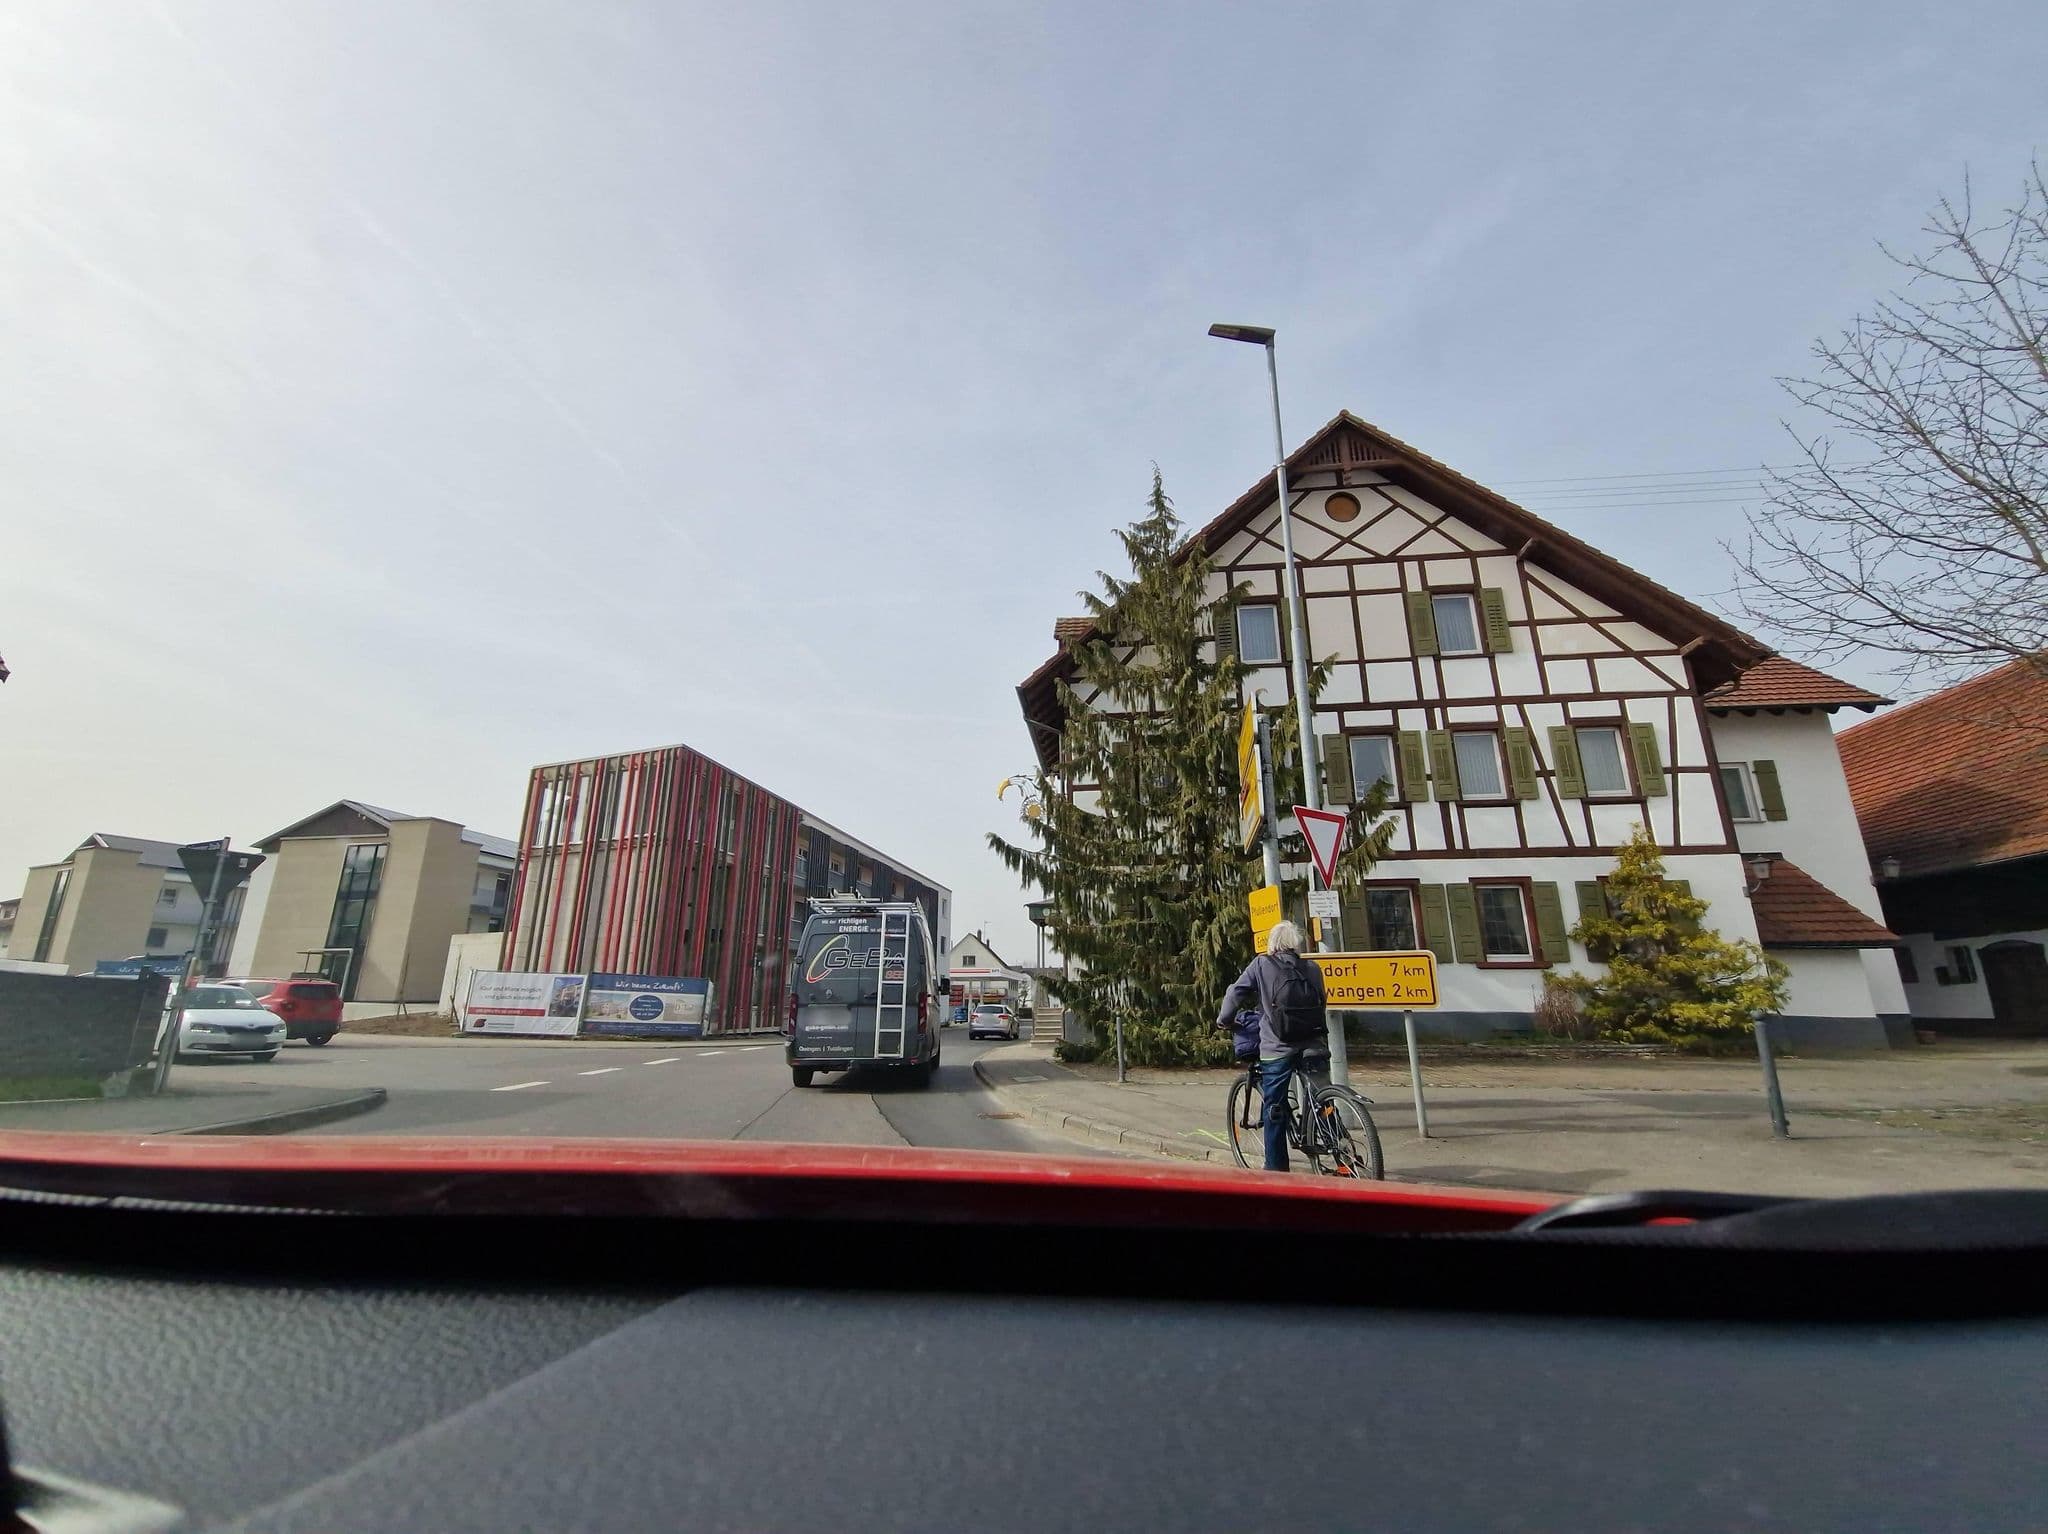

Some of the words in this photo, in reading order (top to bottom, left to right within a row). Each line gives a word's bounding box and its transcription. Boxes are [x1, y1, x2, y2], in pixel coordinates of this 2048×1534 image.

[838, 917, 867, 925] richtigen
[838, 925, 870, 933] ENERGIE
[1321, 963, 1358, 977] dorf
[1389, 962, 1399, 977] 7
[1403, 964, 1425, 977] km
[1326, 986, 1385, 1001] wangen
[1392, 983, 1402, 998] 2
[1406, 985, 1428, 998] km
